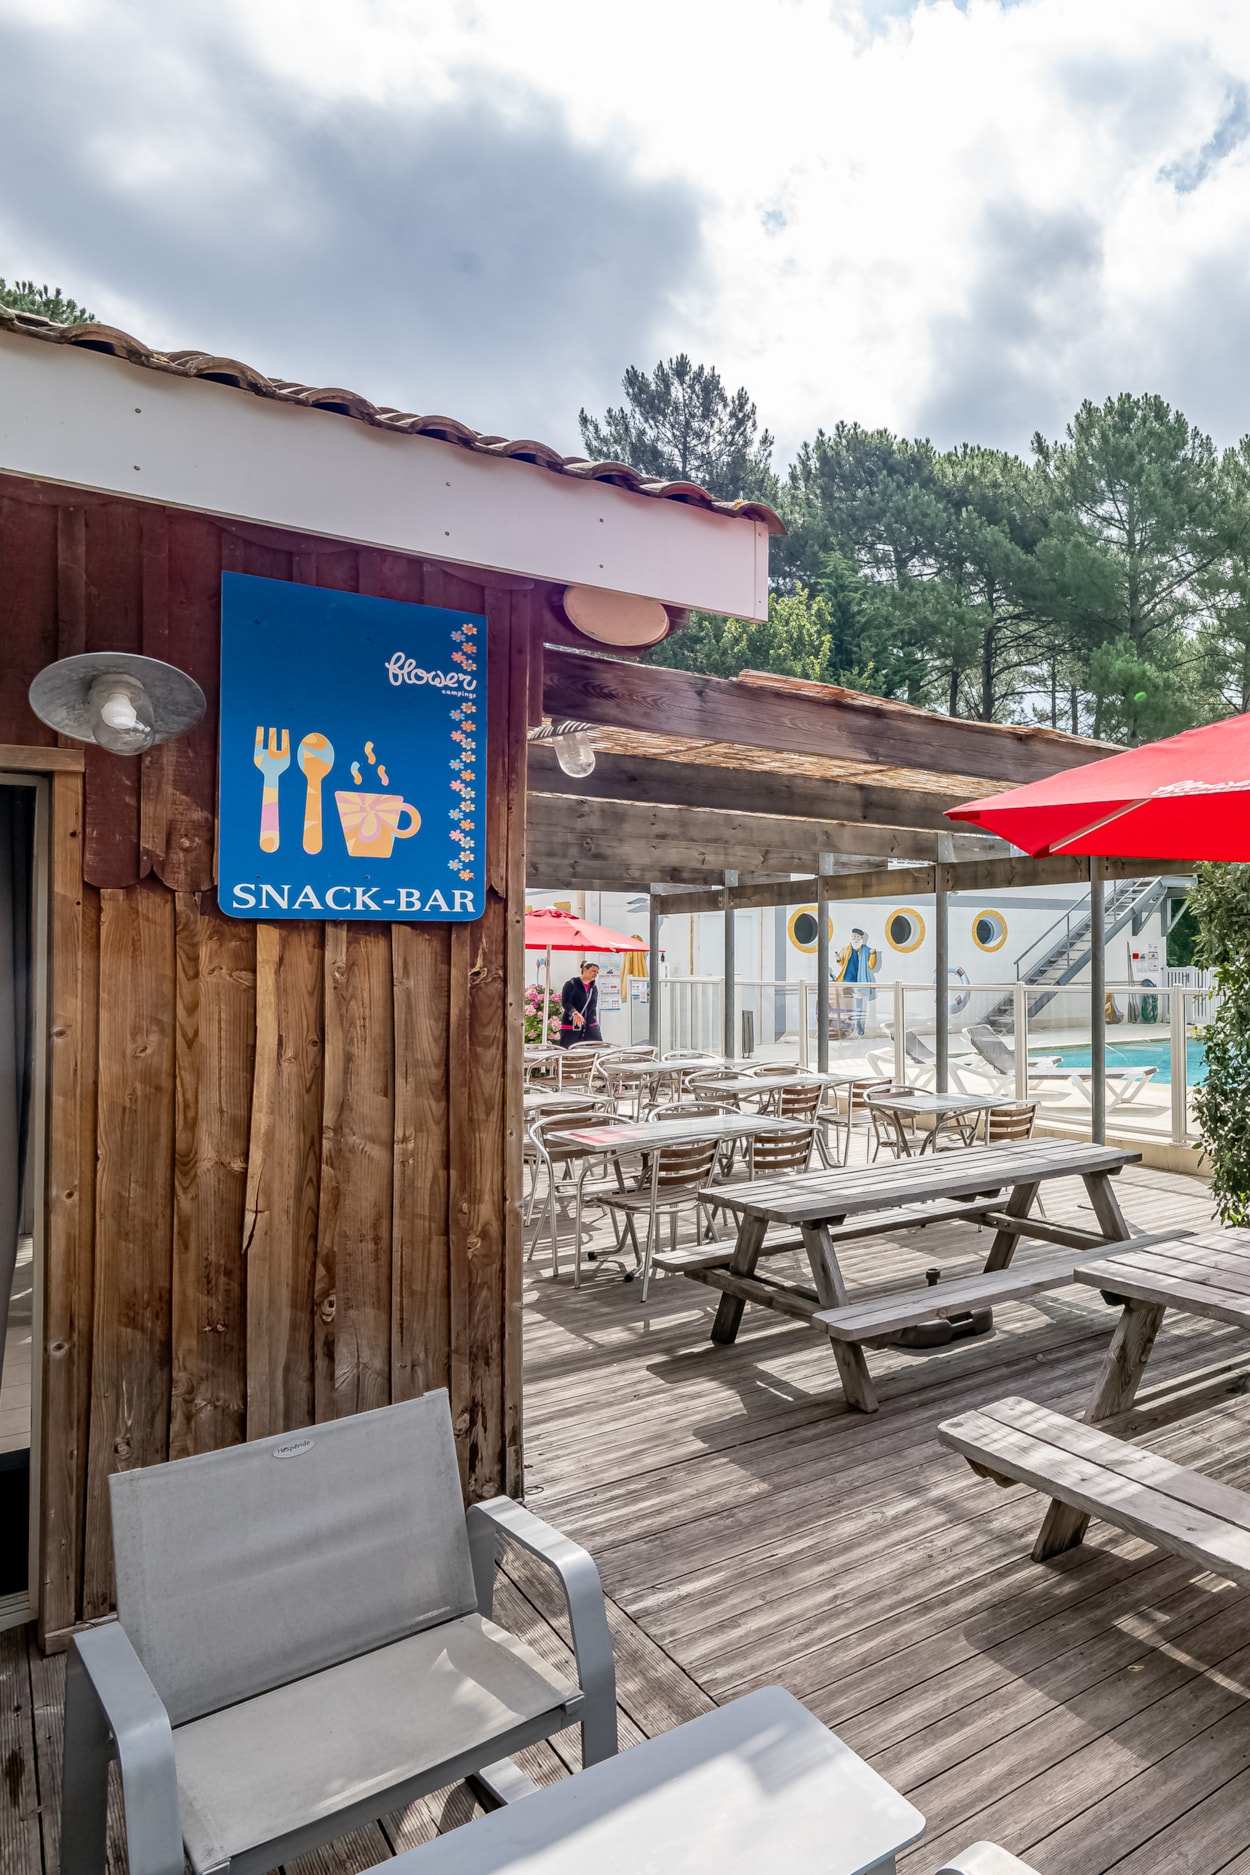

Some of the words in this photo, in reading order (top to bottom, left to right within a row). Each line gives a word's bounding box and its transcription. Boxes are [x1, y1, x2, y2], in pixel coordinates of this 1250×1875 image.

[384, 651, 477, 690] flower
[441, 689, 477, 699] campings
[232, 883, 476, 913] SNACK-BAR
